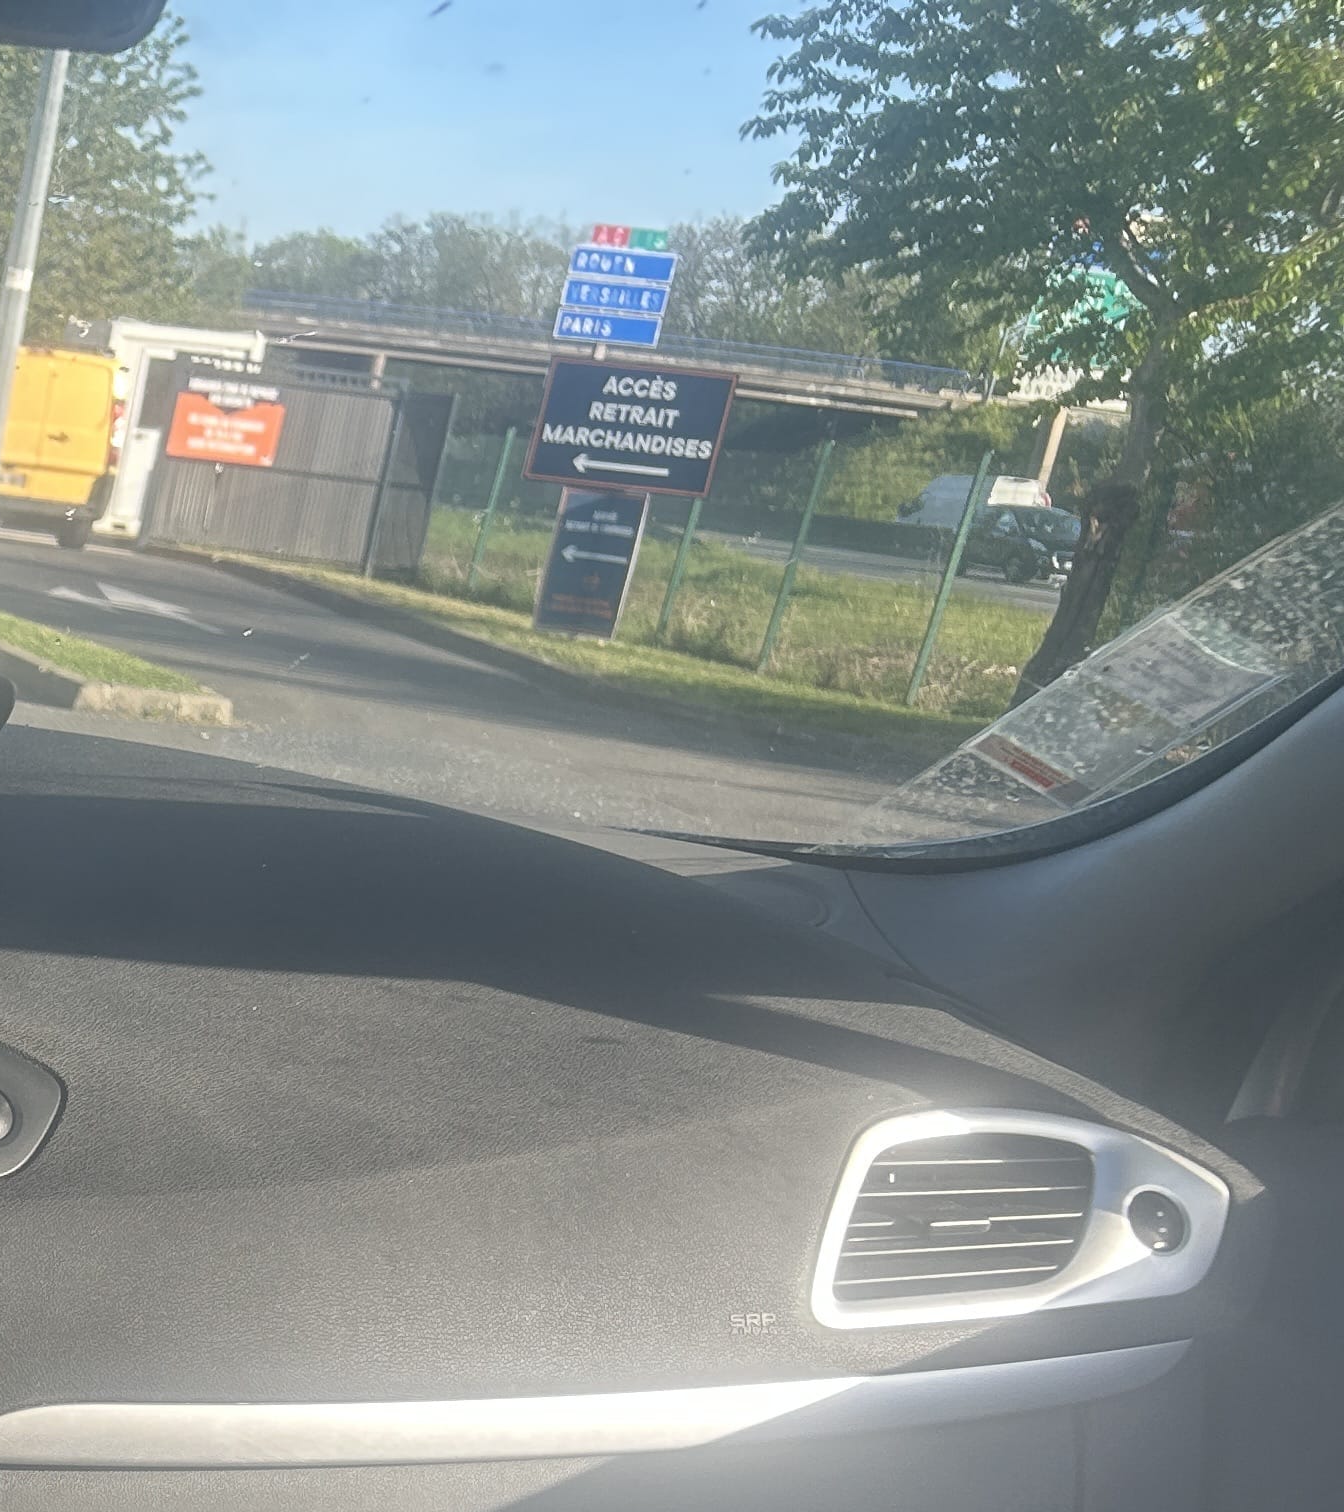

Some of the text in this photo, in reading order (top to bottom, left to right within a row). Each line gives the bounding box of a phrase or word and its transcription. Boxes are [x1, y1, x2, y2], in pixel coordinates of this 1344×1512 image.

[561, 315, 612, 337] PARIS
[601, 375, 678, 402] ACCÈS
[588, 401, 681, 429] RETRAIT
[542, 424, 712, 459] MARCHANDISES
